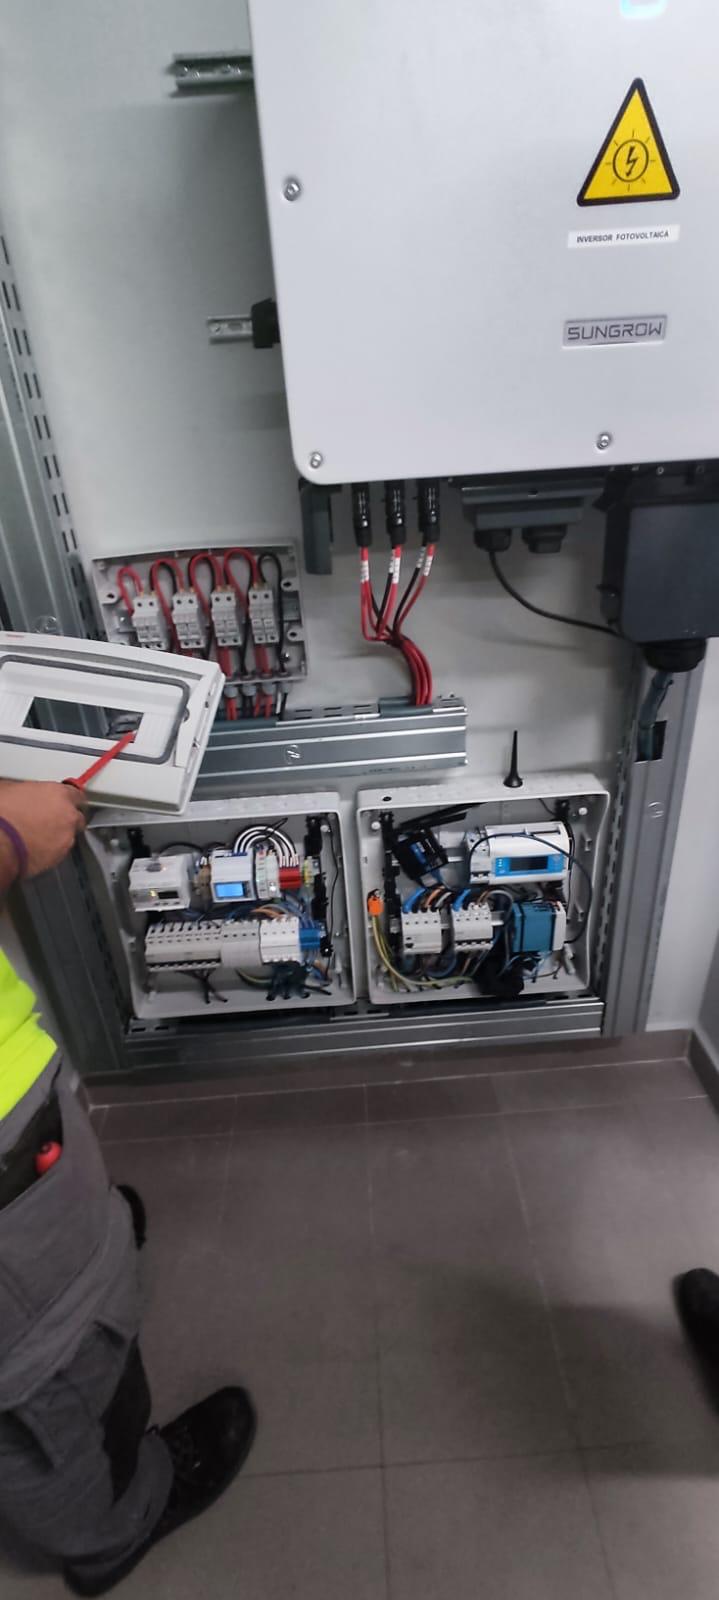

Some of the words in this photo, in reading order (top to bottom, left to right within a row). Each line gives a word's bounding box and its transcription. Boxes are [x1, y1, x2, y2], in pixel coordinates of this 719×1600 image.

[576, 234, 613, 243] INVERSOR
[616, 230, 669, 240] FOTOVOLTAICA
[567, 321, 662, 340] SUNGROW
